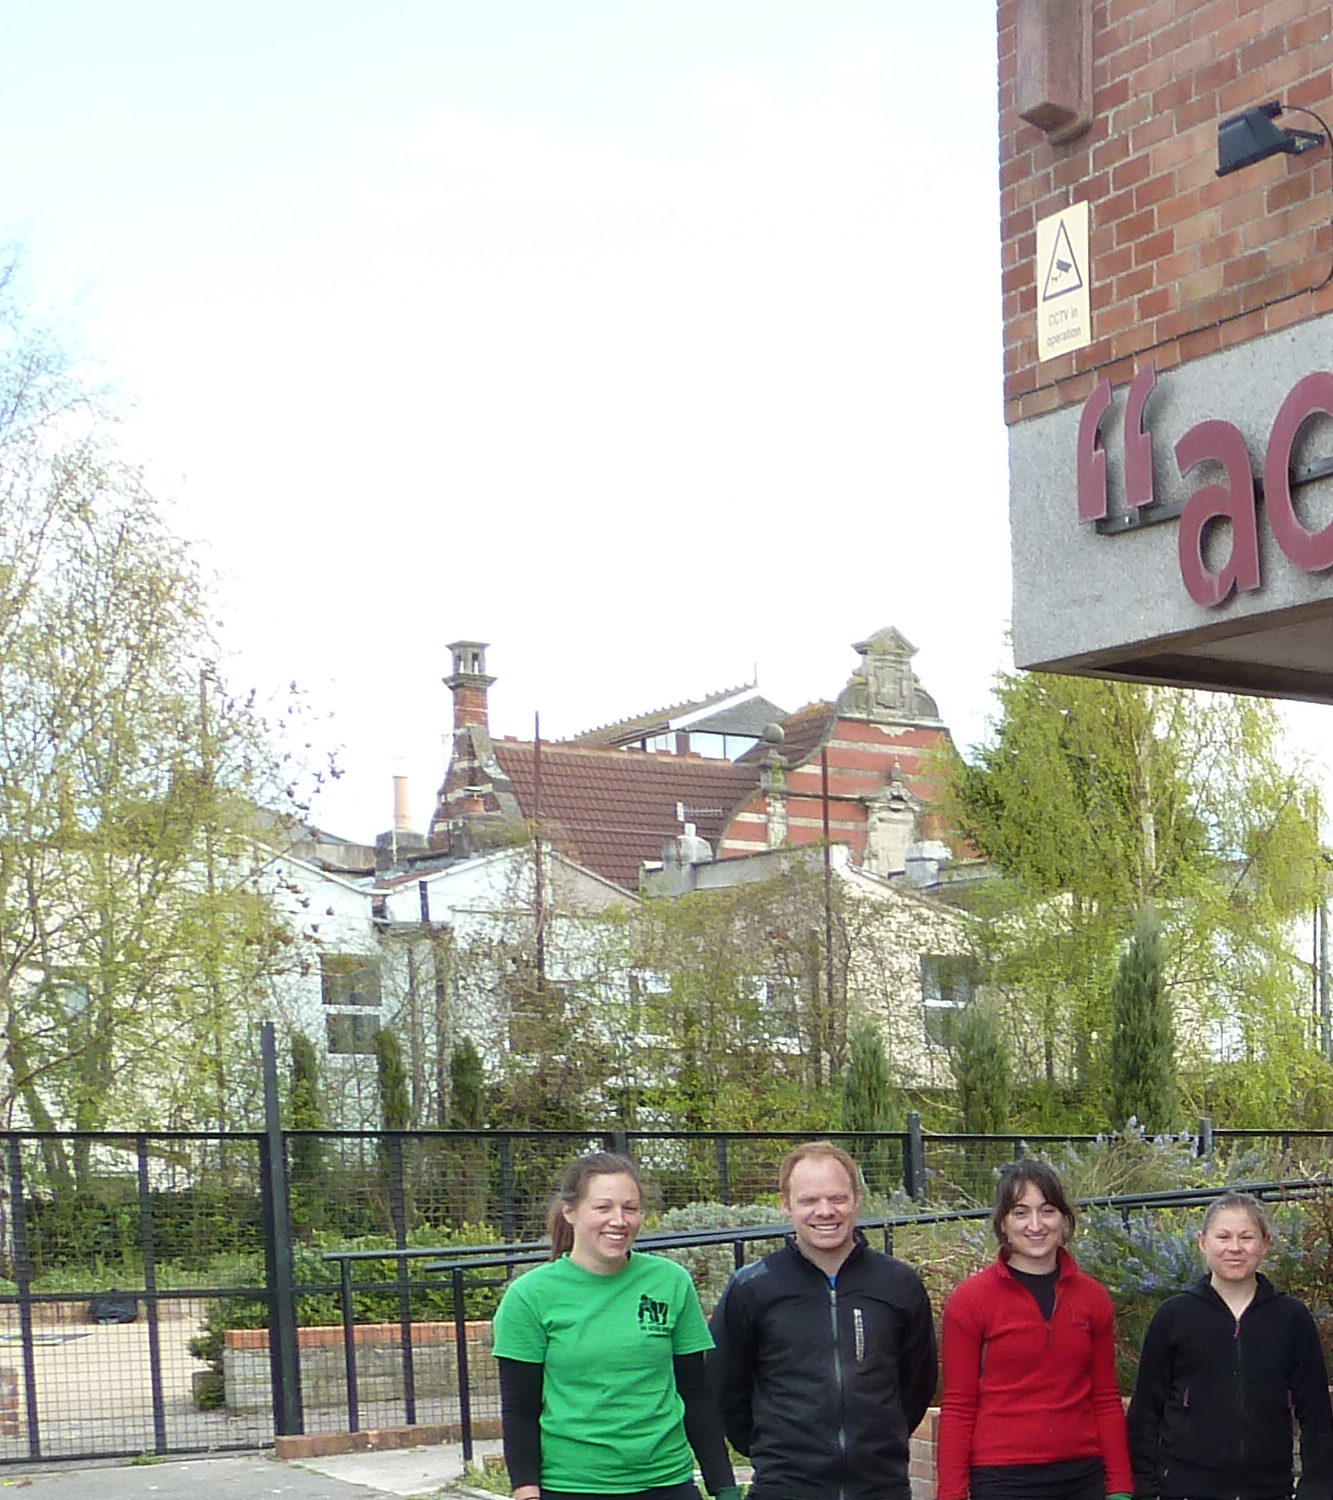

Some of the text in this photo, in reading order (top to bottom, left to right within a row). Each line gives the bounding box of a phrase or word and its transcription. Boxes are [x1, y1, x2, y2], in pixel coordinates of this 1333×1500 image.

[1049, 307, 1078, 326] CCTV in
[1047, 327, 1081, 347] operation
